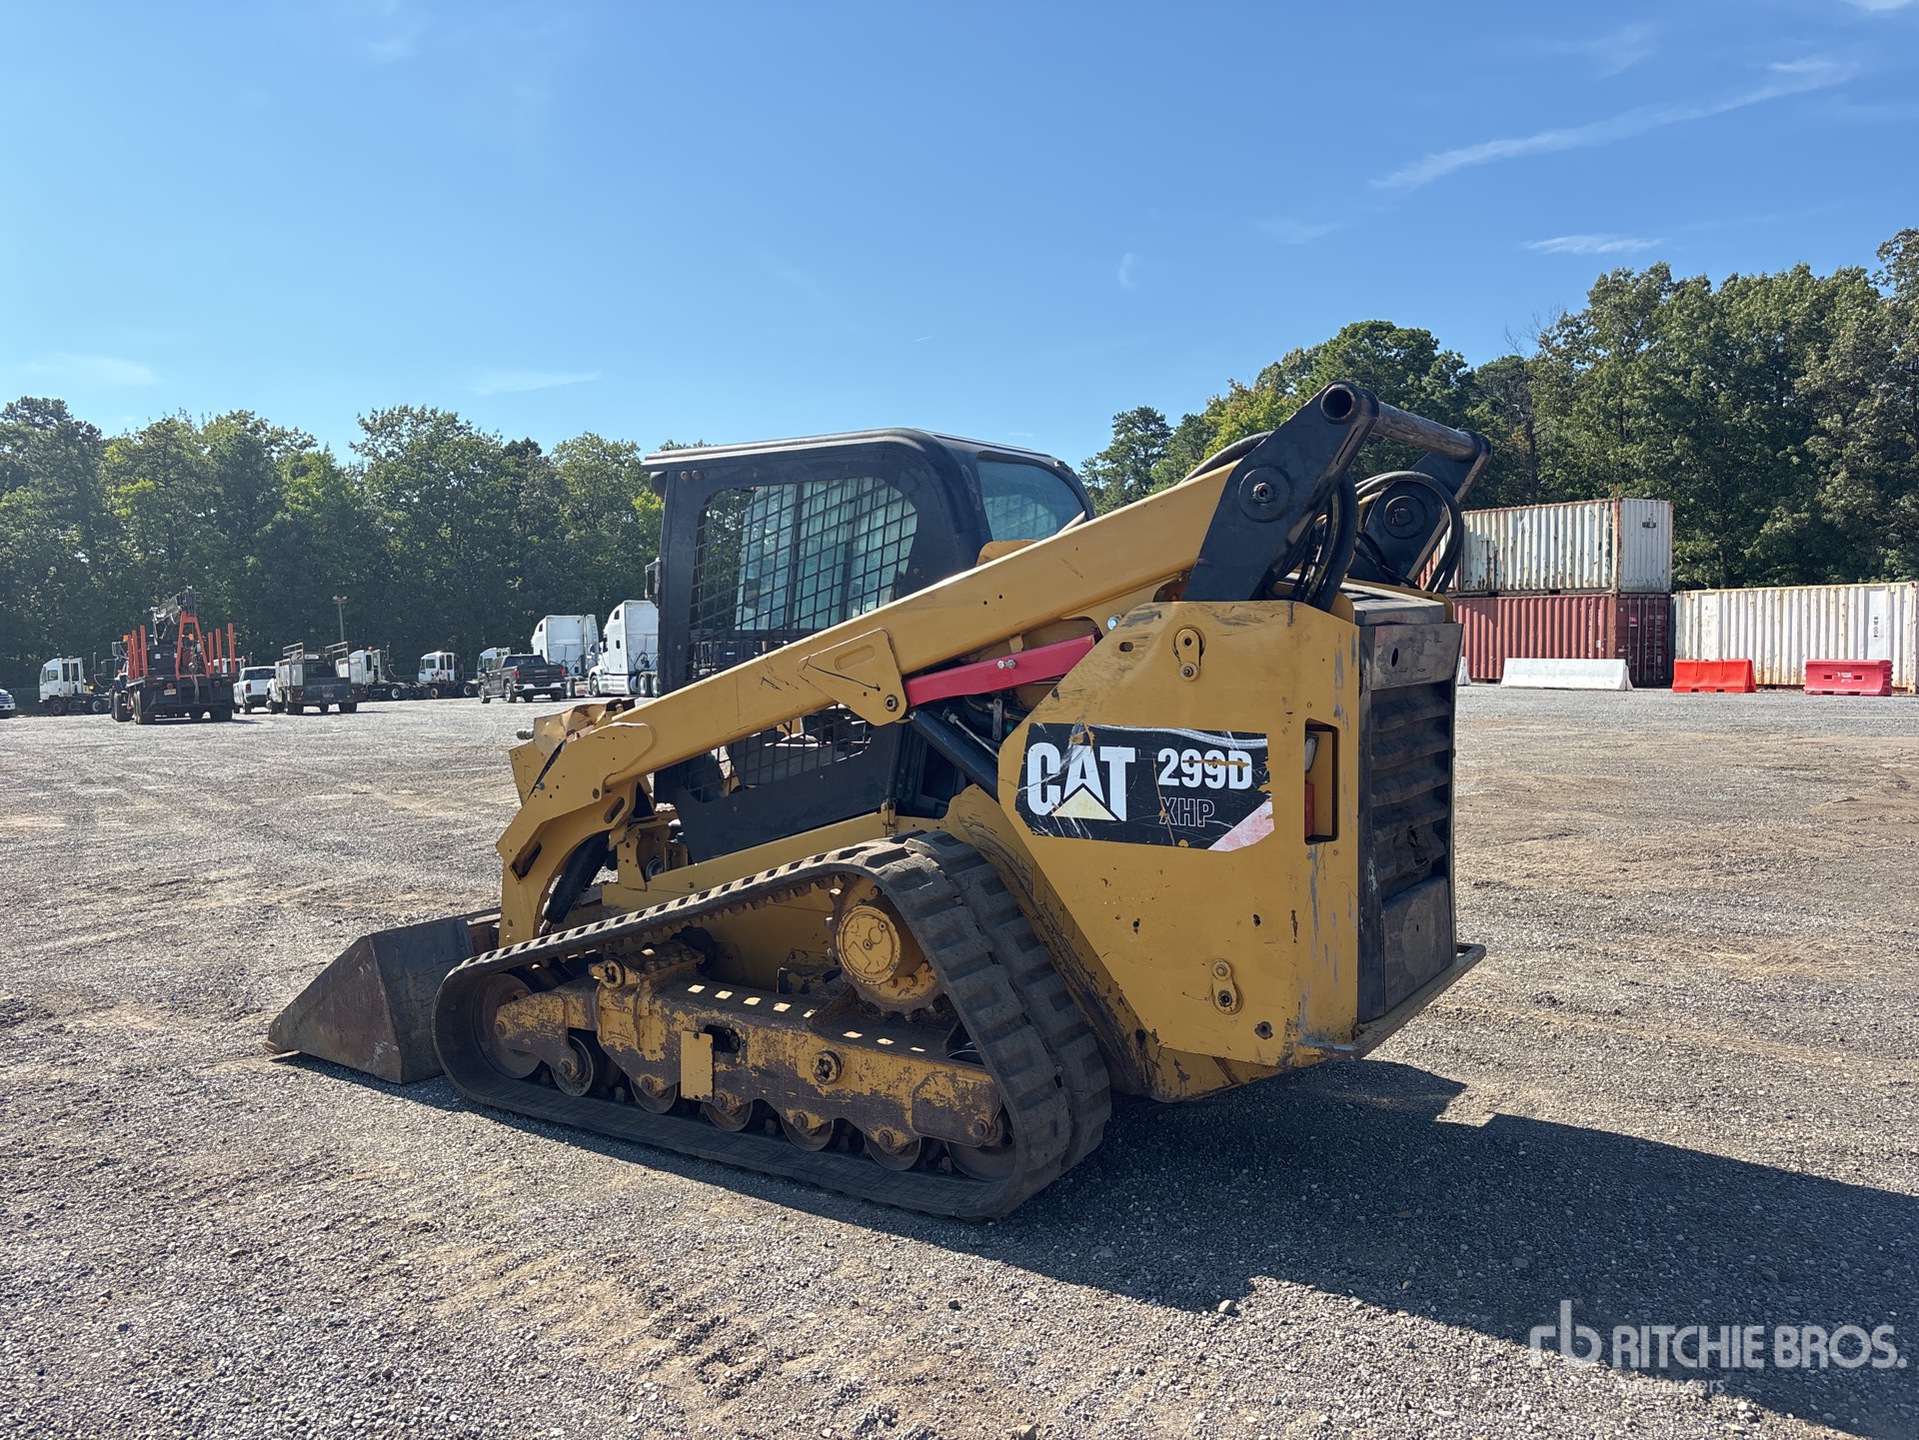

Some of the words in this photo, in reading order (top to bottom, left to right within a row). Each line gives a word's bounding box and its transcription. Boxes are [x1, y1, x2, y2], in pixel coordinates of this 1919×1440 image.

[1027, 742, 1136, 821] CAT
[1157, 747, 1252, 789] 299D
[1159, 796, 1215, 827] XHP
